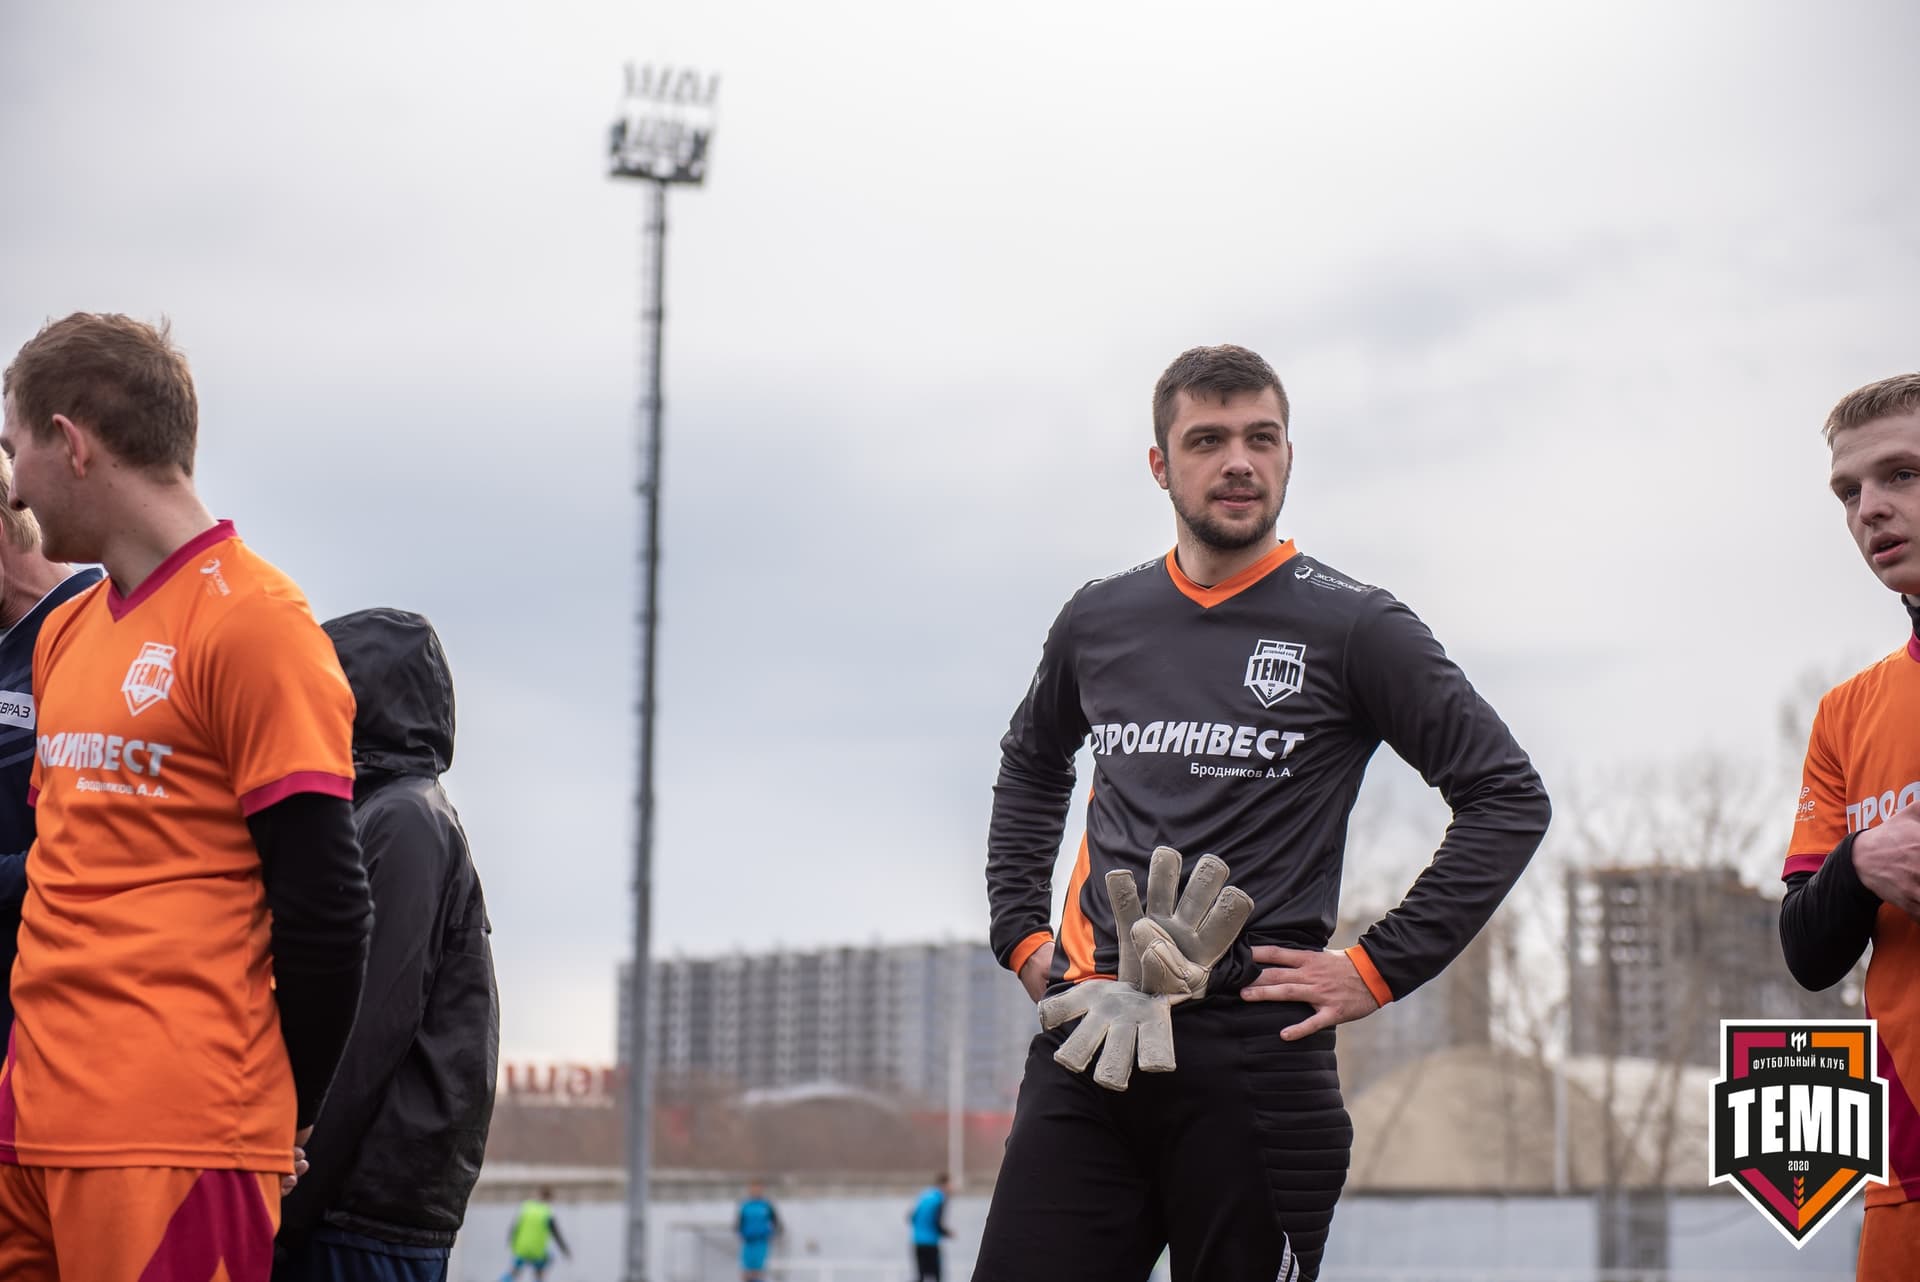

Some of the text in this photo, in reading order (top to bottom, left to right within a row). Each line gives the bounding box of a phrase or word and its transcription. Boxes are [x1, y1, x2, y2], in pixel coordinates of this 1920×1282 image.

[128, 663, 171, 693] ТЕМП
[1251, 658, 1301, 687] ТЕМП
[0, 701, 31, 718] ВРАЗ
[1091, 720, 1305, 760] ПРОДИНВЕСТ
[1190, 762, 1263, 778] Бродников
